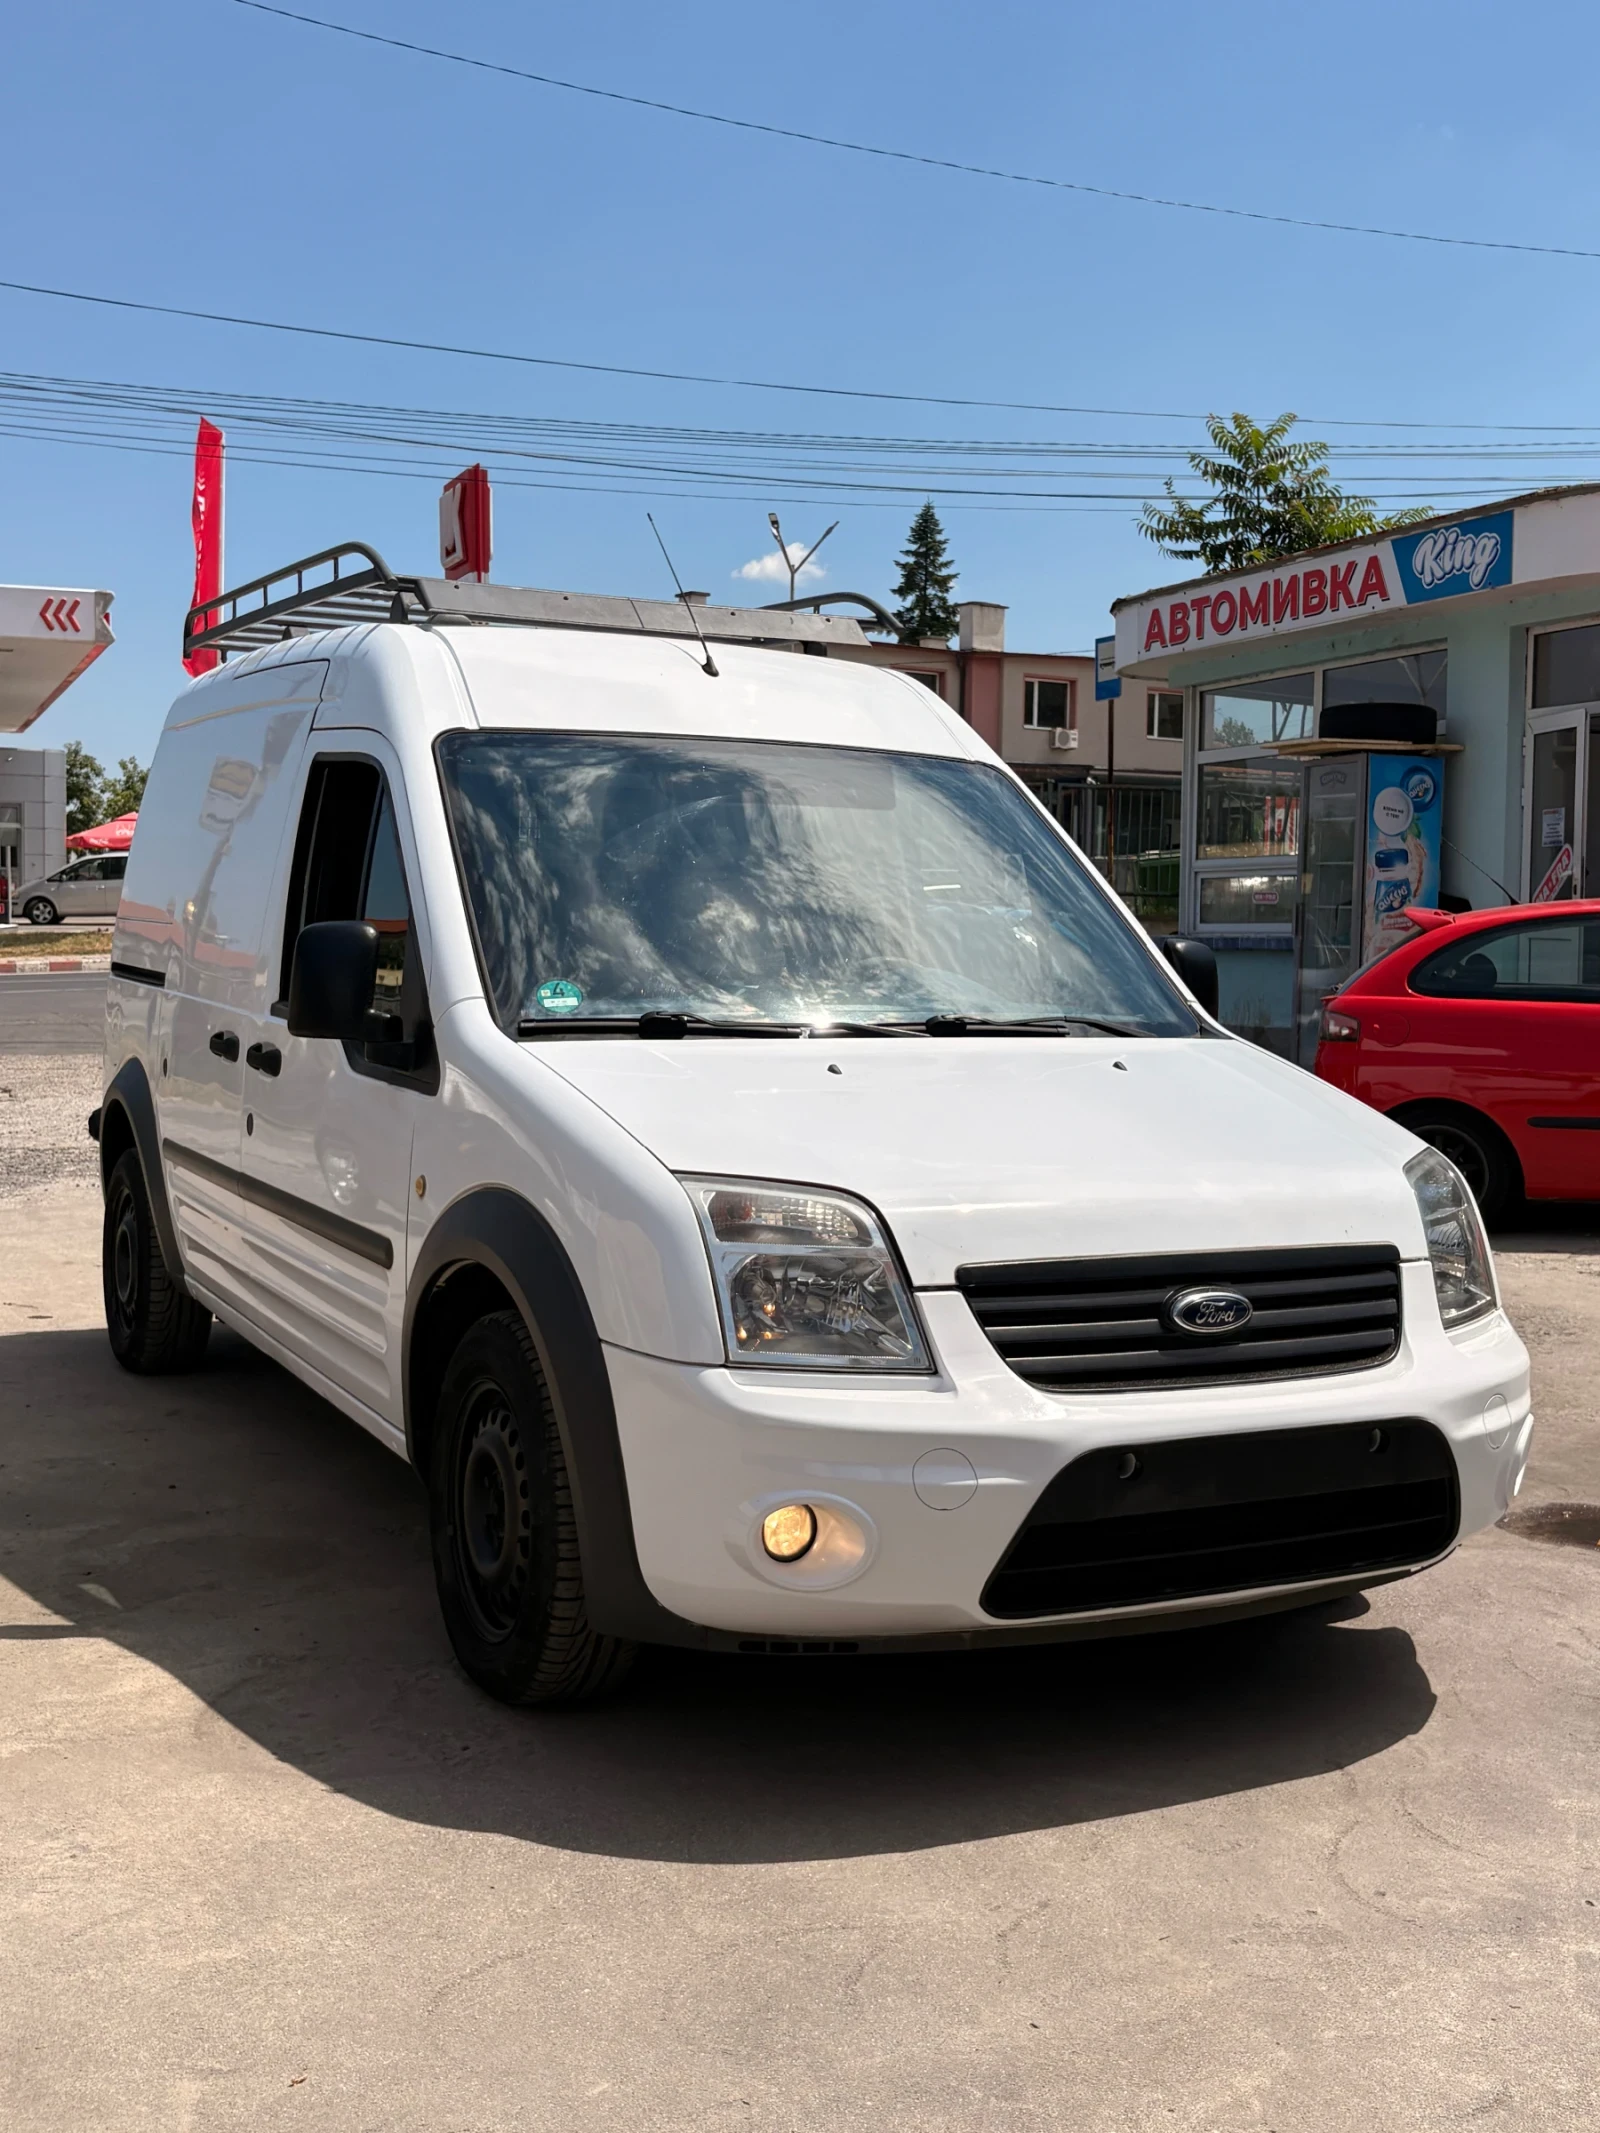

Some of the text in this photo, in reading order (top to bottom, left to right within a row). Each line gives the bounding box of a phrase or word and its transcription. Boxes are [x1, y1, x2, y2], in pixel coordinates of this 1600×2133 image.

[1413, 528, 1499, 590] King
[1144, 555, 1390, 651] АВТОМИВКА
[553, 982, 565, 996] 4
[1196, 1301, 1236, 1324] Ford
